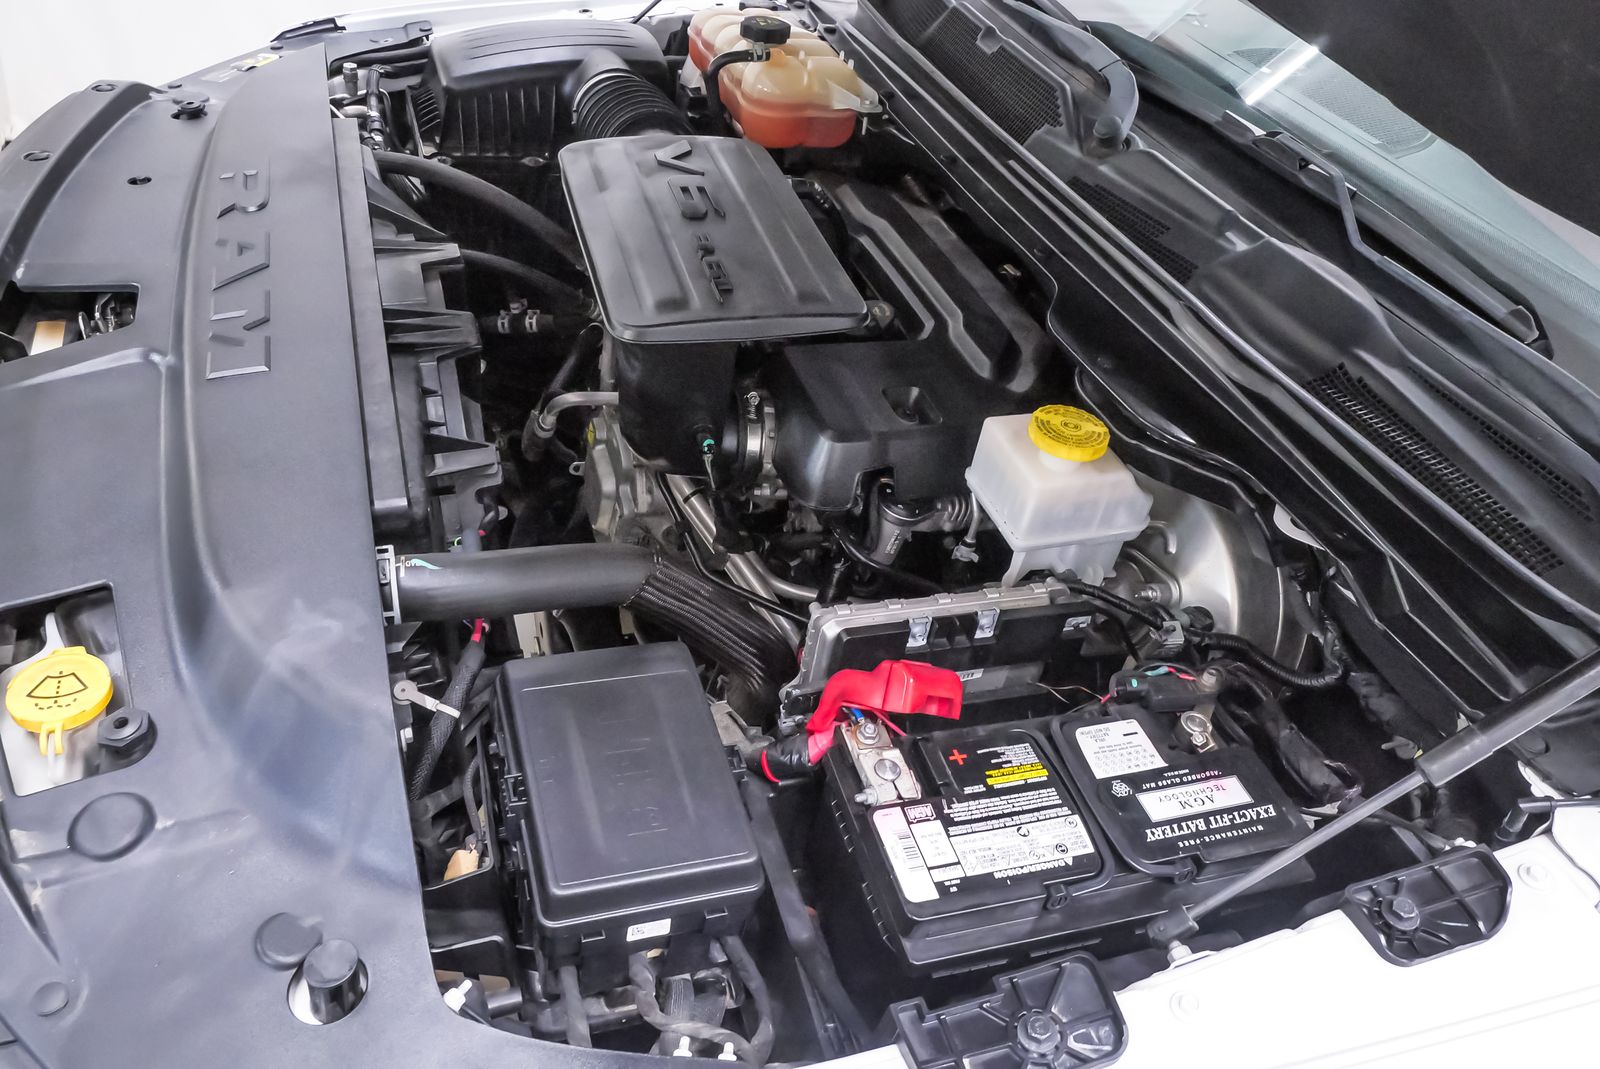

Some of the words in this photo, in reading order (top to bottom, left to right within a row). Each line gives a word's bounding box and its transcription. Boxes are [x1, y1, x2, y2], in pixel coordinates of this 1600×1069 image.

[206, 157, 271, 380] RAM
[1142, 782, 1155, 790] MAT
[1158, 777, 1181, 787] GLASS
[1158, 784, 1226, 803] TECHNOLOGY
[1178, 794, 1215, 809] AGM
[905, 805, 932, 819] AGM
[1208, 804, 1277, 829] EXACT-FIT
[1145, 818, 1208, 842] BATTERY
[1178, 825, 1264, 848] MAINTENANCE-FREE
[994, 859, 1066, 879] DANGER/POISON
